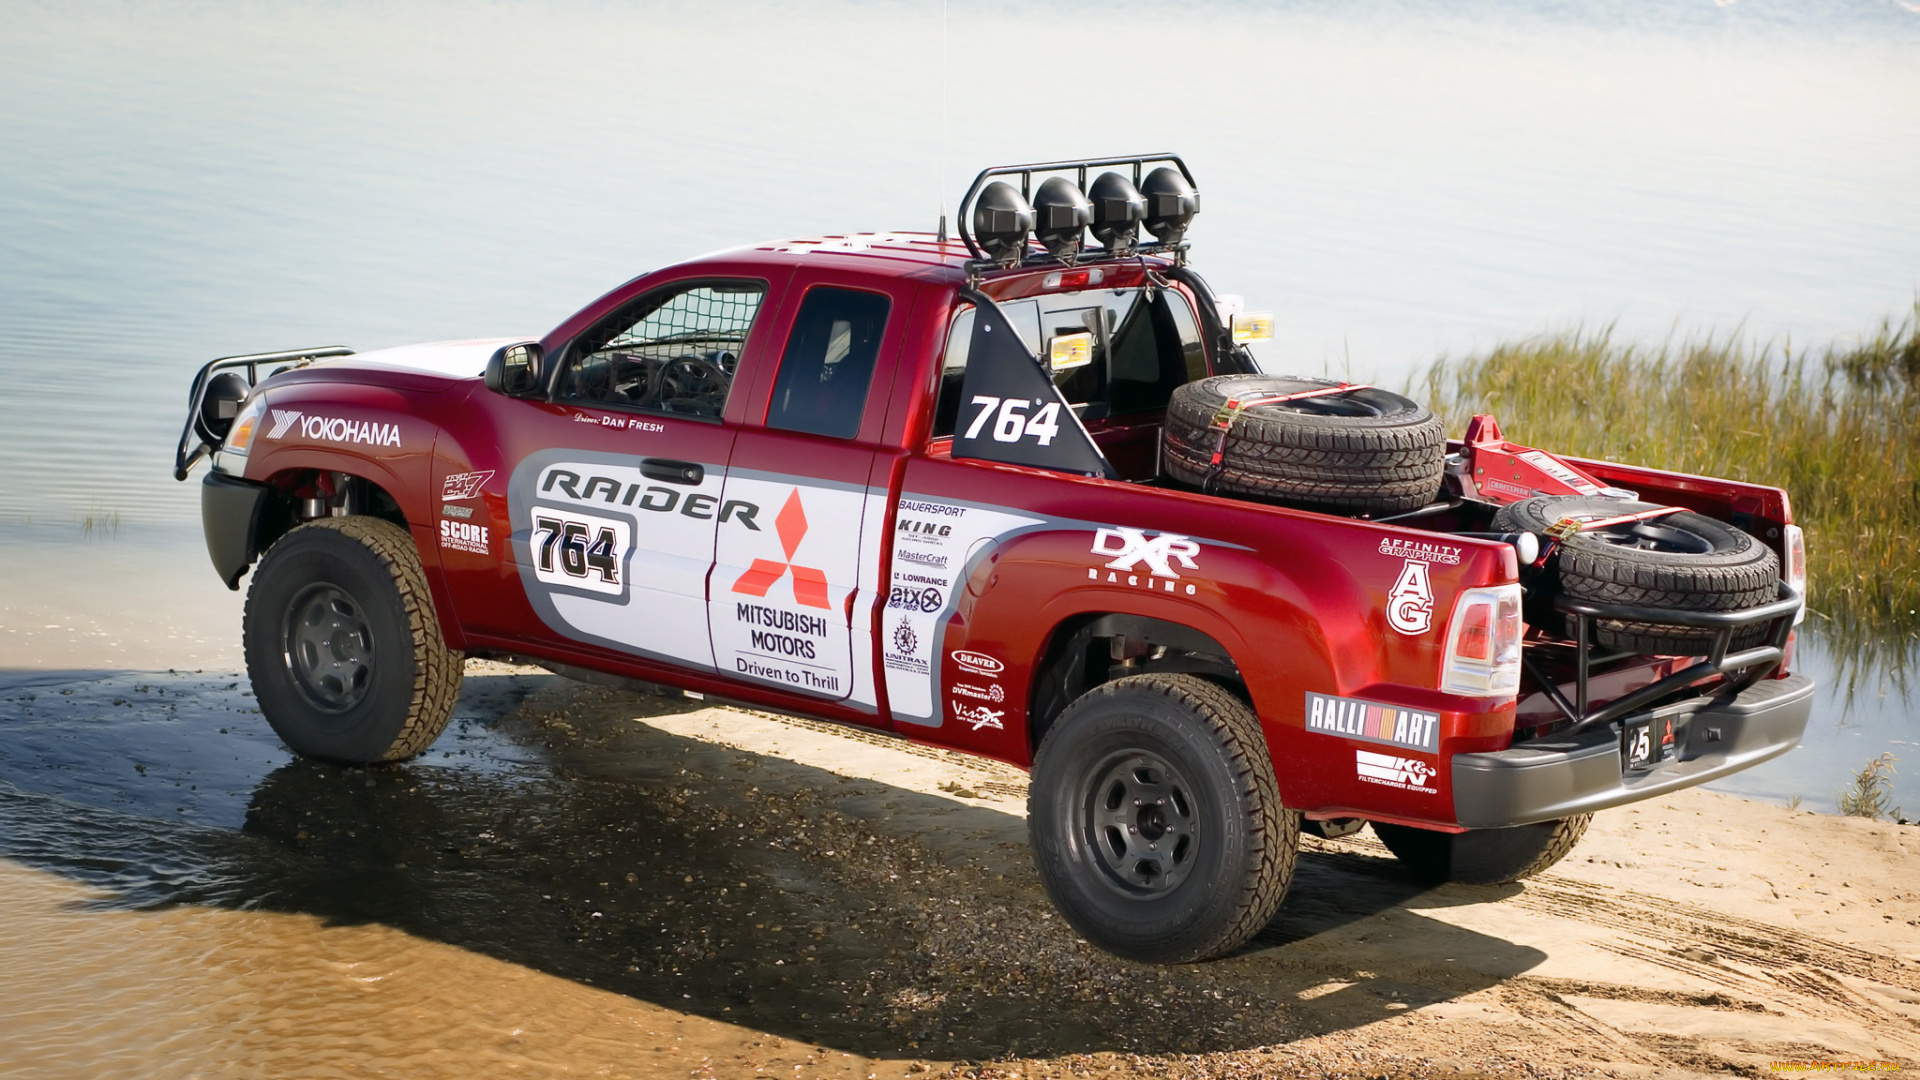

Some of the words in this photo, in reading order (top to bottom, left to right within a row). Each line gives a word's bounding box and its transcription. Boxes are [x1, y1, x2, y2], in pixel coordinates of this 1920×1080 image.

[299, 415, 402, 448] YOKOHAMA
[602, 416, 626, 429] DAN
[628, 419, 665, 433] FRESH
[963, 395, 1062, 447] 764
[541, 469, 762, 532] RAIDER
[1490, 480, 1530, 497] CRAFTSMAN
[898, 500, 967, 517] BAUERSPORT
[440, 519, 489, 544] SCORE
[897, 519, 952, 537] KING
[441, 535, 488, 551] INTERNATIONAL
[533, 514, 620, 586] 764
[1090, 526, 1201, 580] DXR
[1378, 545, 1461, 566] GRAPHICS
[1380, 537, 1462, 557] AFFINITY
[897, 548, 948, 565] MasterCraft
[903, 573, 948, 587] LOWRANCE
[1088, 567, 1197, 596] RACING
[737, 602, 827, 638] MITSUBISHI
[751, 629, 816, 660] MOTORS
[960, 650, 995, 669] DEAVER
[736, 657, 782, 681] Driven
[785, 669, 800, 683] to
[802, 670, 839, 692] Thrill
[1629, 726, 1650, 761] 25
[1394, 757, 1437, 786] K&N
[1358, 775, 1406, 790] FILTERCHARGER
[1407, 784, 1437, 795] EQUIPPED
